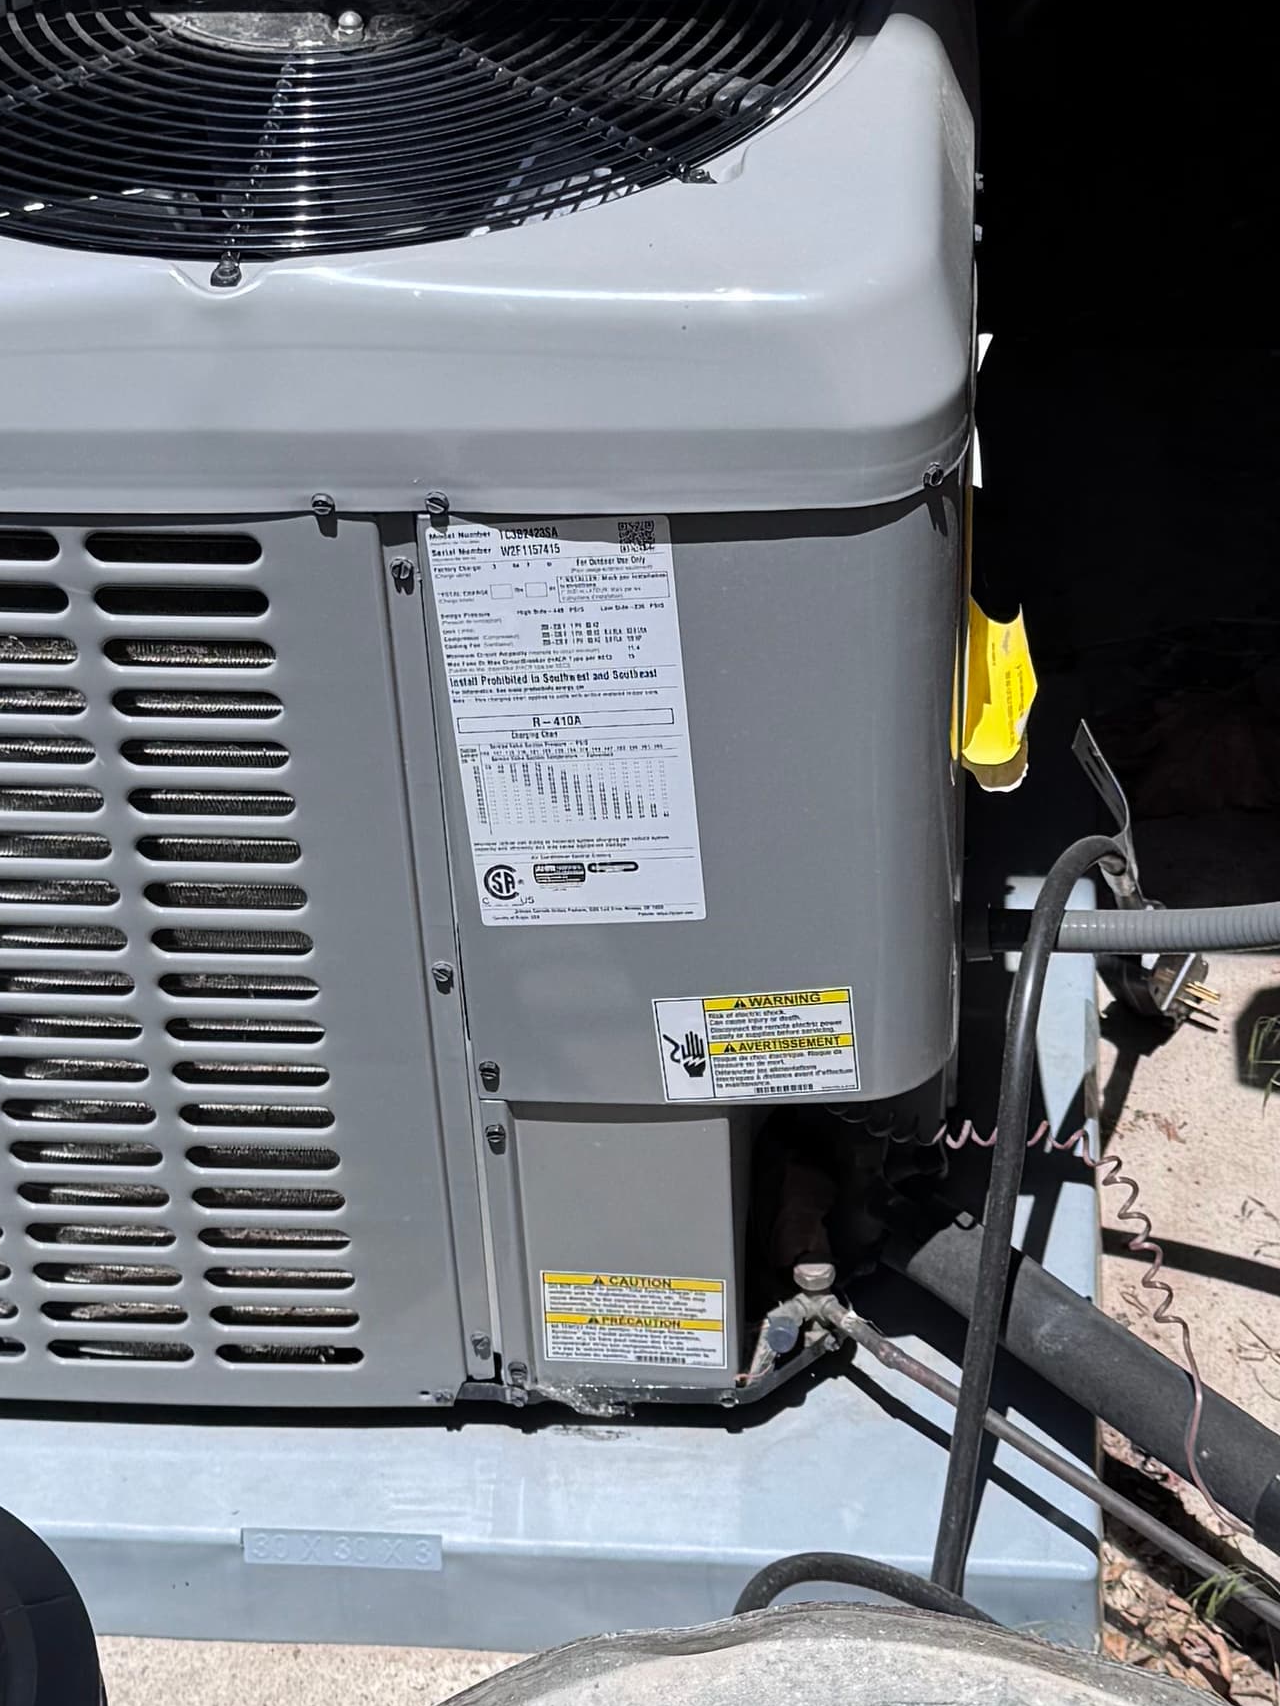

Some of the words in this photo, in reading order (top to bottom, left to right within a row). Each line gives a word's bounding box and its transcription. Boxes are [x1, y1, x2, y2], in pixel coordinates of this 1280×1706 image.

[450, 676, 478, 687] Install
[481, 675, 528, 686] Prohibited
[543, 671, 589, 684] Southwest
[592, 670, 609, 681] and
[612, 668, 657, 680] Southeast
[748, 993, 821, 1008] WARNING
[820, 1020, 842, 1028] power
[738, 1036, 840, 1052] AVERTISSEMENT
[609, 1276, 672, 1289] CAUTION
[601, 1315, 681, 1329] PRÉCAUTION
[301, 1534, 322, 1562] X
[382, 1537, 404, 1564] X
